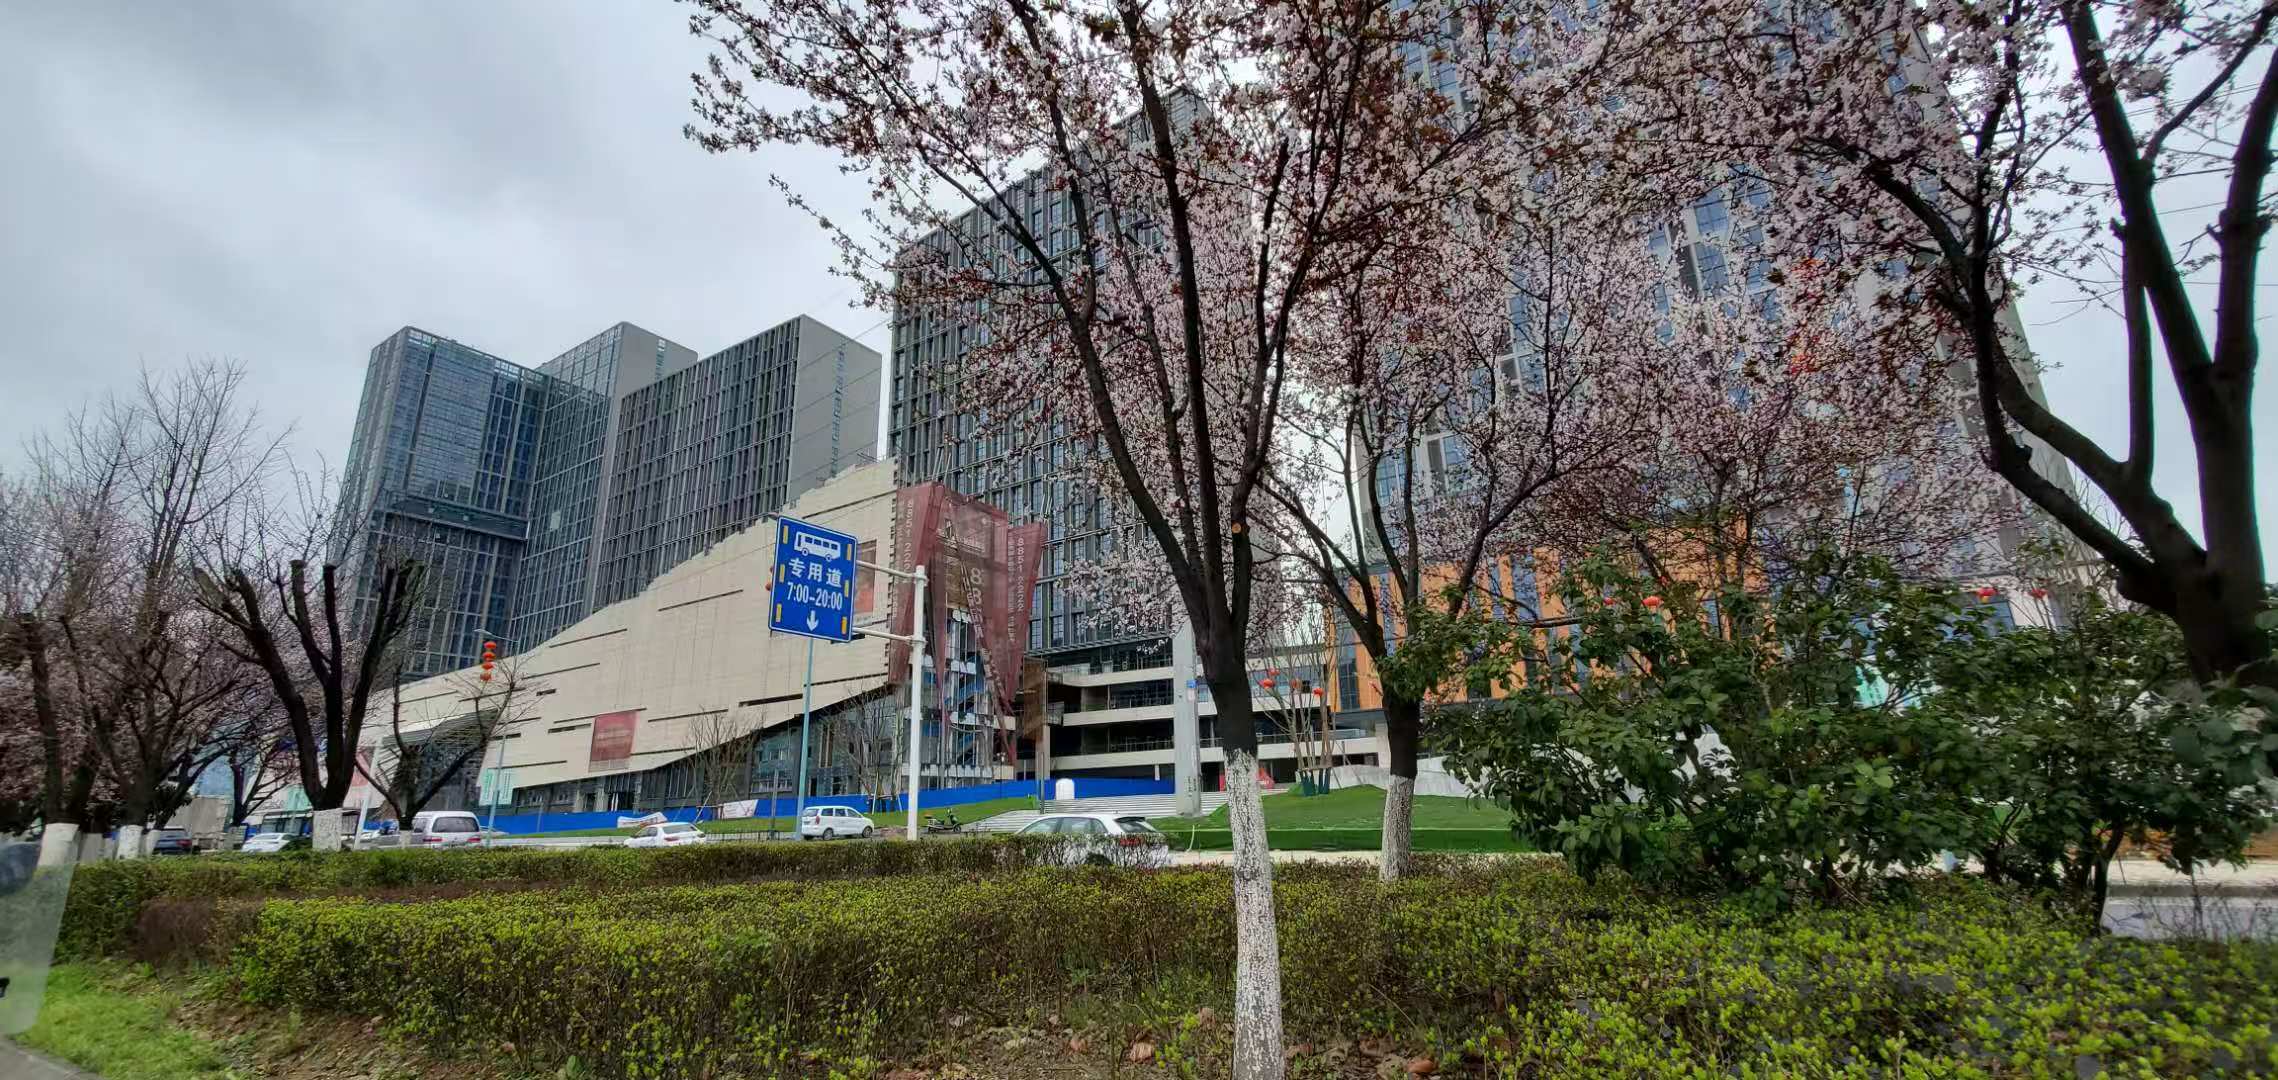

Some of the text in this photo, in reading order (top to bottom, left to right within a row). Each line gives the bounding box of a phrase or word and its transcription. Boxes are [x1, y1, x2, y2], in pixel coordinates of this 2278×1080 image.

[788, 557, 842, 588] 专用道
[787, 582, 843, 611] 7:00-20:00
